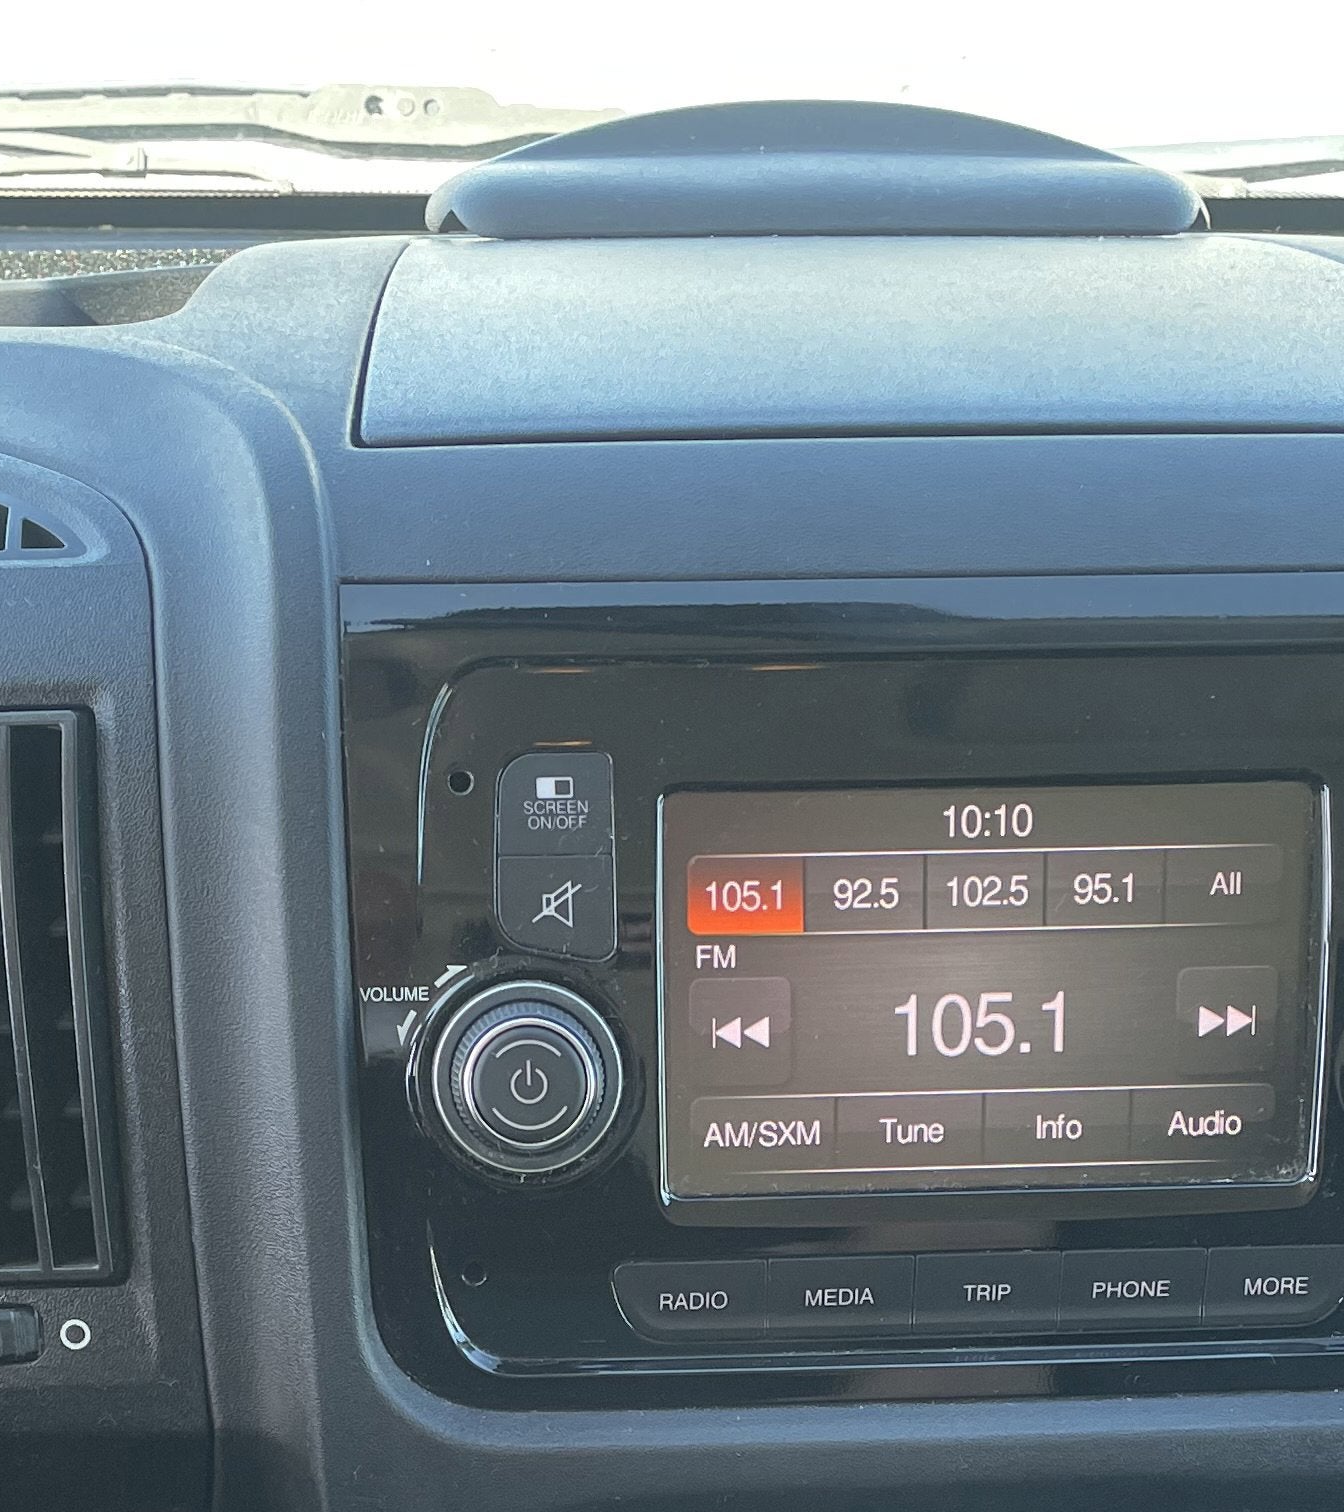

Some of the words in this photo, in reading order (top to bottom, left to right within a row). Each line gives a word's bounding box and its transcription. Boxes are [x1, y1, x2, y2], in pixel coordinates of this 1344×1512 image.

[522, 799, 589, 815] SCREEN
[527, 816, 588, 830] ON/OFF
[943, 803, 1033, 839] 10:10
[704, 878, 786, 912] 105.1
[833, 877, 899, 910] 92.5
[947, 874, 1029, 907] 102.5
[1073, 872, 1133, 905] 95.1
[1209, 871, 1242, 896] All
[696, 944, 736, 969] FM
[359, 986, 430, 1002] VOLUME
[894, 990, 1064, 1057] 105.1
[703, 1120, 821, 1148] AM/SXM
[878, 1118, 945, 1144] Tune
[1036, 1113, 1082, 1140] Info
[1167, 1109, 1242, 1137] Audio
[805, 1287, 874, 1306] MEDIA
[963, 1283, 1011, 1302] TRIP
[1092, 1280, 1170, 1299] PHONE
[1244, 1276, 1309, 1296] MORE
[659, 1291, 728, 1311] RADIO
